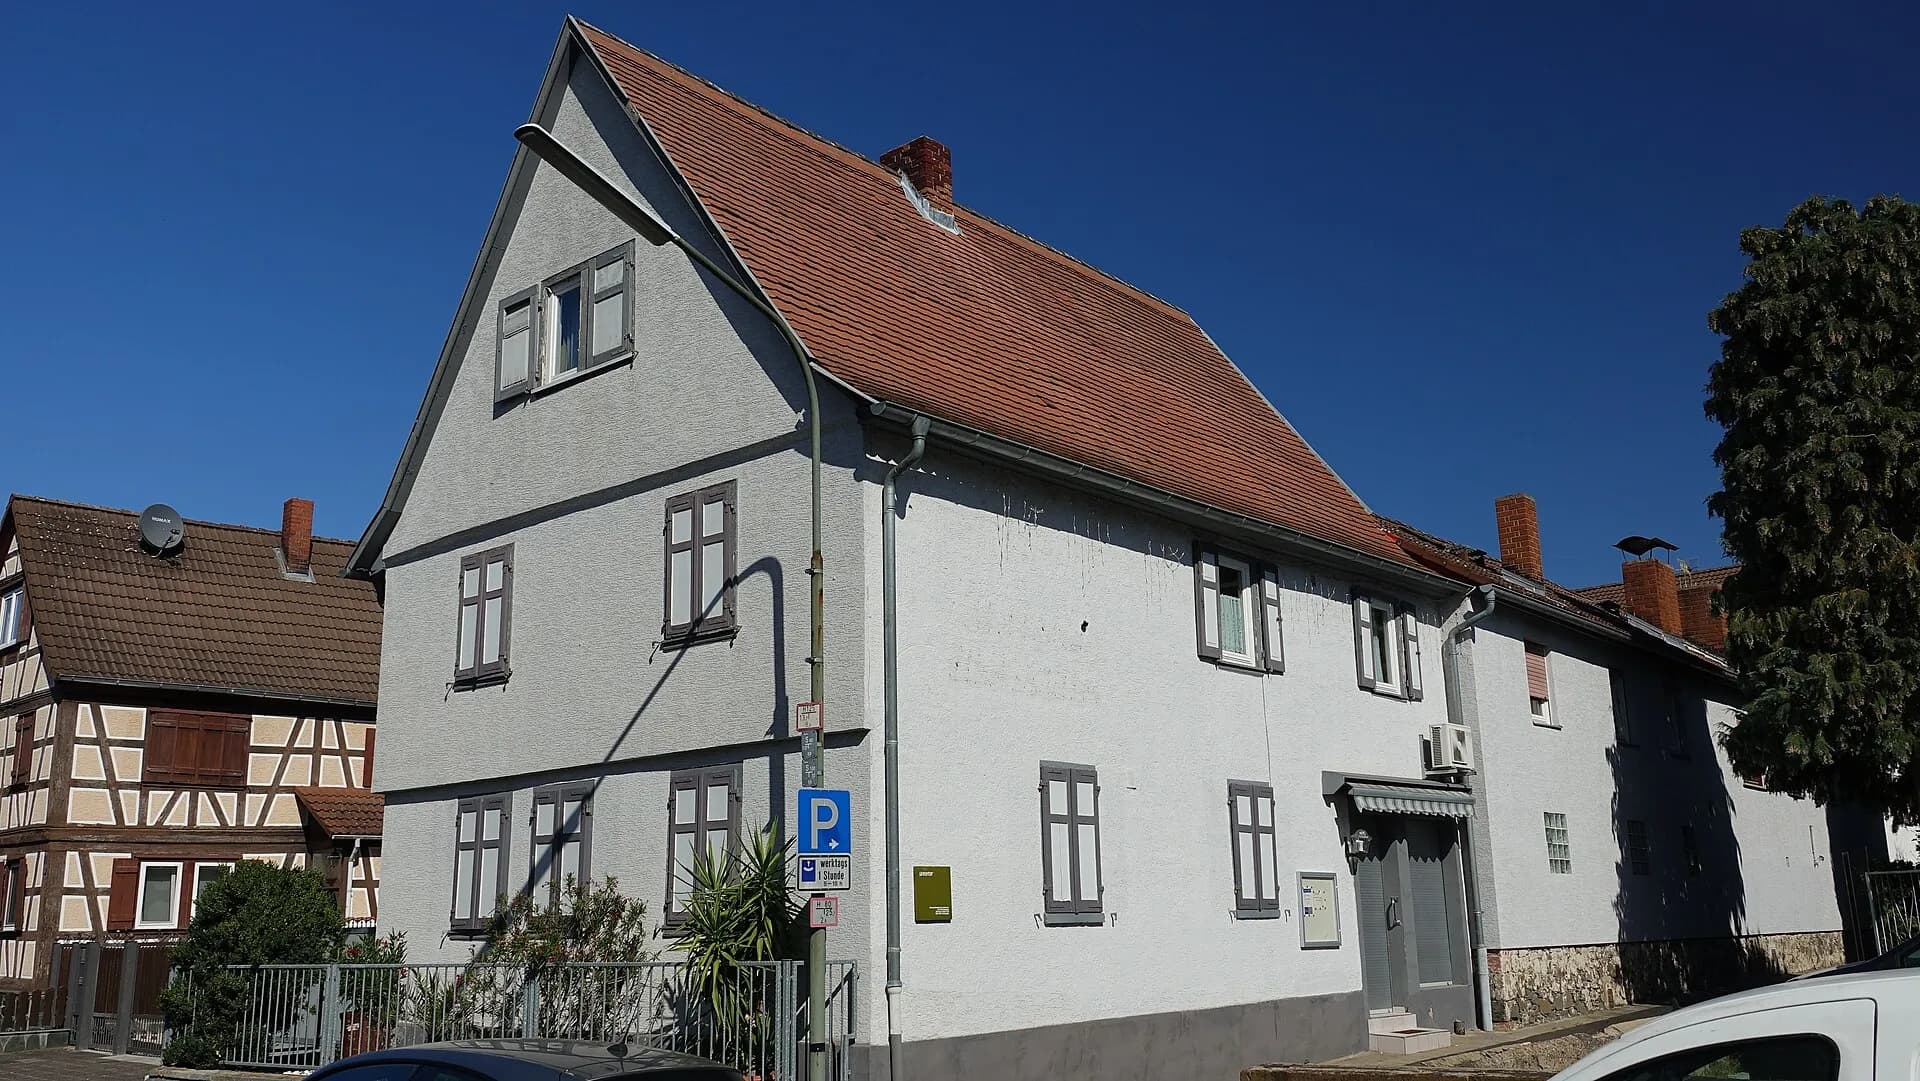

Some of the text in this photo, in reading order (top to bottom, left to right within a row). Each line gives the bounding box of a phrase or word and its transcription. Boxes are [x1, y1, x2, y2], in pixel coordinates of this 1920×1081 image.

[811, 798, 839, 849] P
[820, 858, 848, 869] werktags
[823, 870, 845, 881] Stunde
